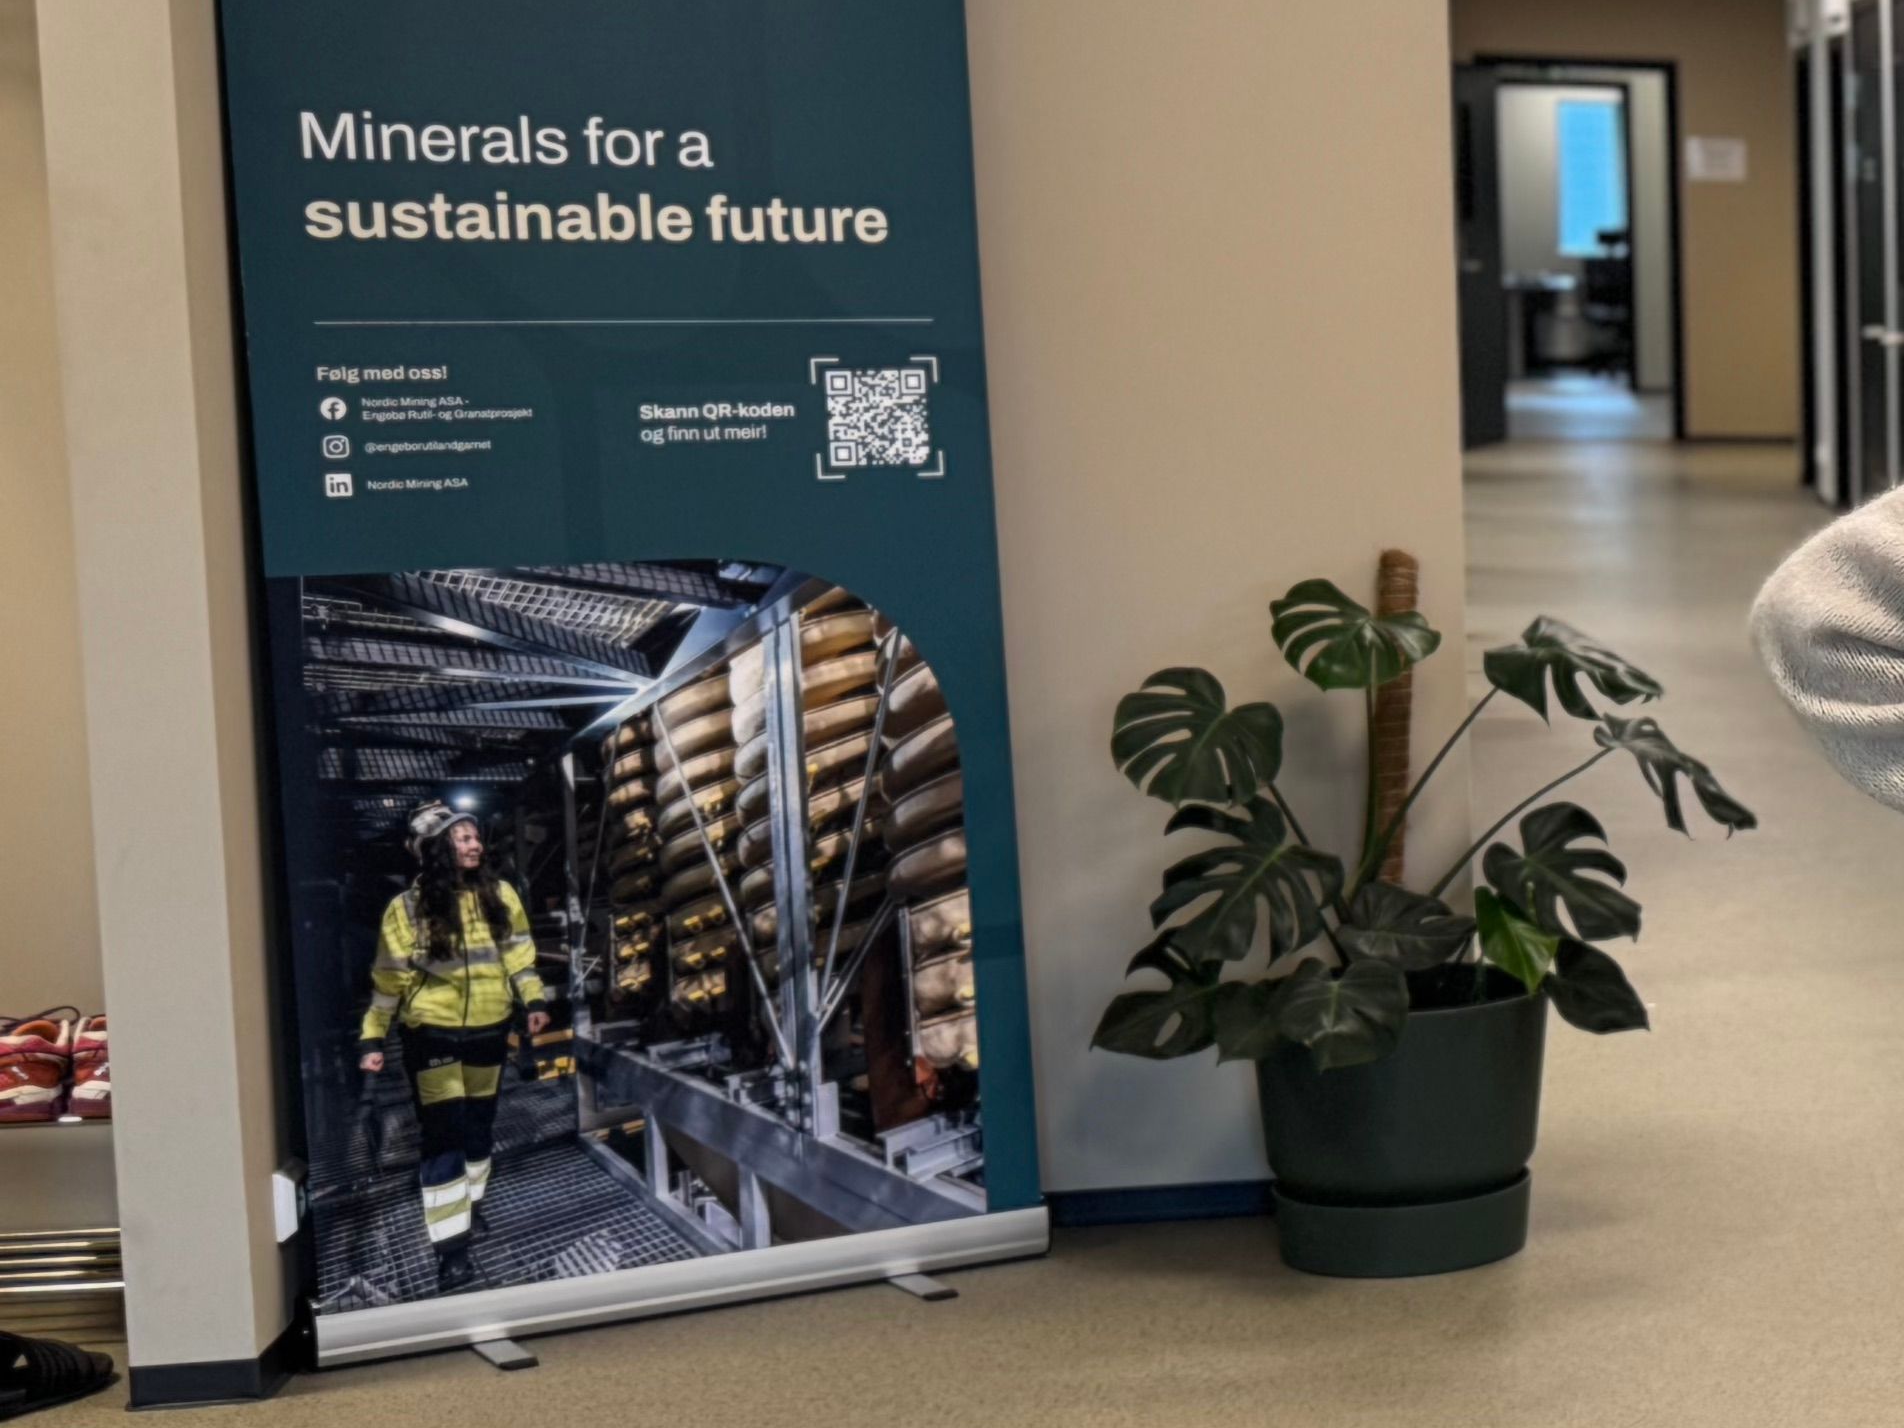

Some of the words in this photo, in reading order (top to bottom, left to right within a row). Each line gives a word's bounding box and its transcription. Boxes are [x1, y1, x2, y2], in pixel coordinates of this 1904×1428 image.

[300, 110, 569, 166] Minerals
[583, 116, 664, 167] for
[678, 129, 714, 168] a
[304, 191, 693, 242] sustainable
[705, 194, 889, 244] future
[316, 366, 360, 384] Følg
[364, 365, 404, 380] med
[409, 365, 448, 380] oss!
[640, 405, 699, 420] Skann
[702, 402, 795, 420] QR-koden
[641, 428, 664, 445] og
[668, 426, 699, 441] finn
[703, 426, 720, 440] ut
[724, 425, 767, 440] meir!
